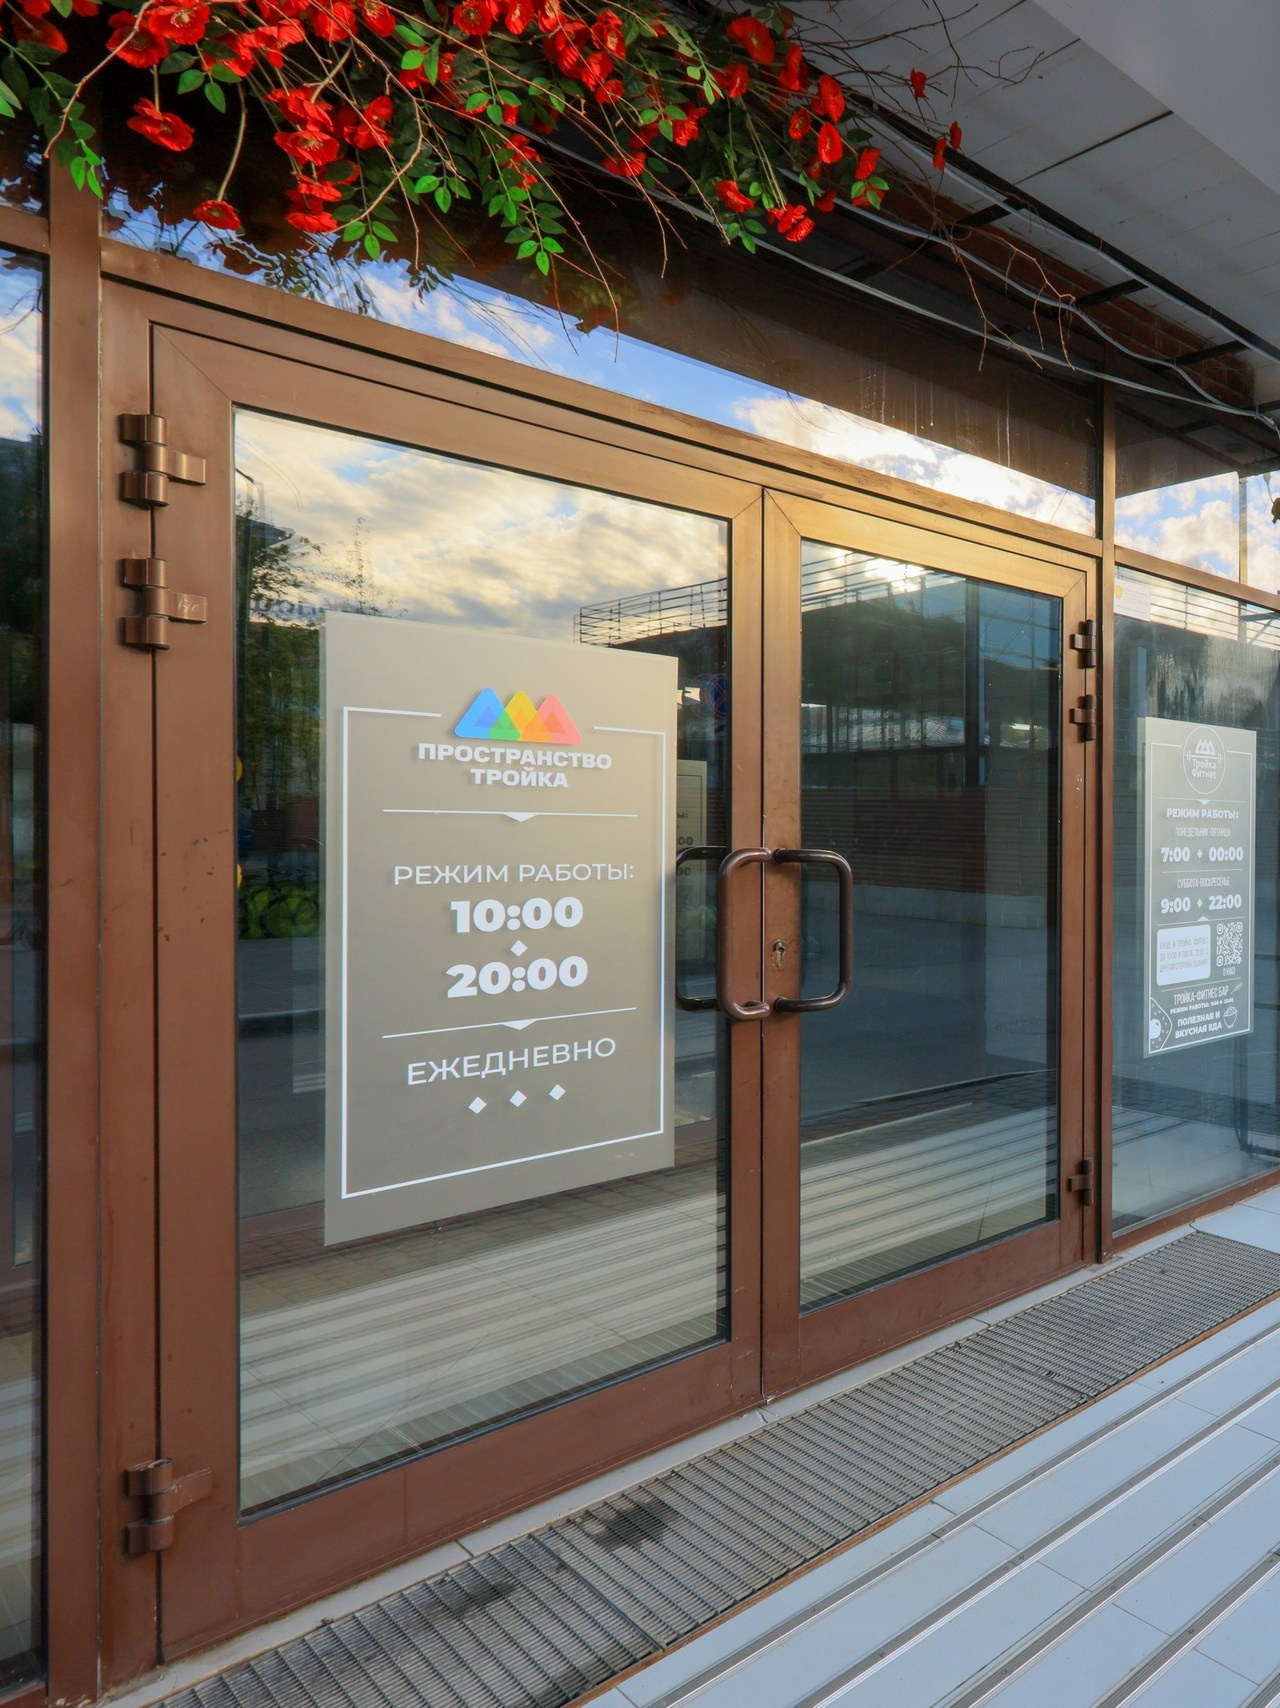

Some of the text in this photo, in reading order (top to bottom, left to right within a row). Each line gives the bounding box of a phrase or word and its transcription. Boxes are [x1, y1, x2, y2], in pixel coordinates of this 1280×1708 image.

[418, 743, 612, 770] ПРОСТРАНСТВО
[1192, 759, 1217, 771] Тройка
[470, 767, 569, 789] ТРОЙКА
[1191, 768, 1217, 779] Фитнес
[1166, 807, 1239, 820] РЕЖИМ РАБОТЫ:
[1161, 846, 1244, 862] 7:00 00:00
[393, 862, 634, 886] РЕЖИМ РАБОТЫ:
[1161, 894, 1242, 914] 9:00 22:00
[450, 897, 583, 934] 10:00
[445, 955, 588, 998] 20:00
[1173, 985, 1230, 1006] ТРОЙКА-ФИТНЕС БАР
[1177, 1011, 1221, 1027] ПОЛЕЗНАЯ И
[1175, 1022, 1223, 1039] ВКУСНАЯ ЕДА
[407, 1037, 616, 1086] ЕЖЕДНЕВНО
